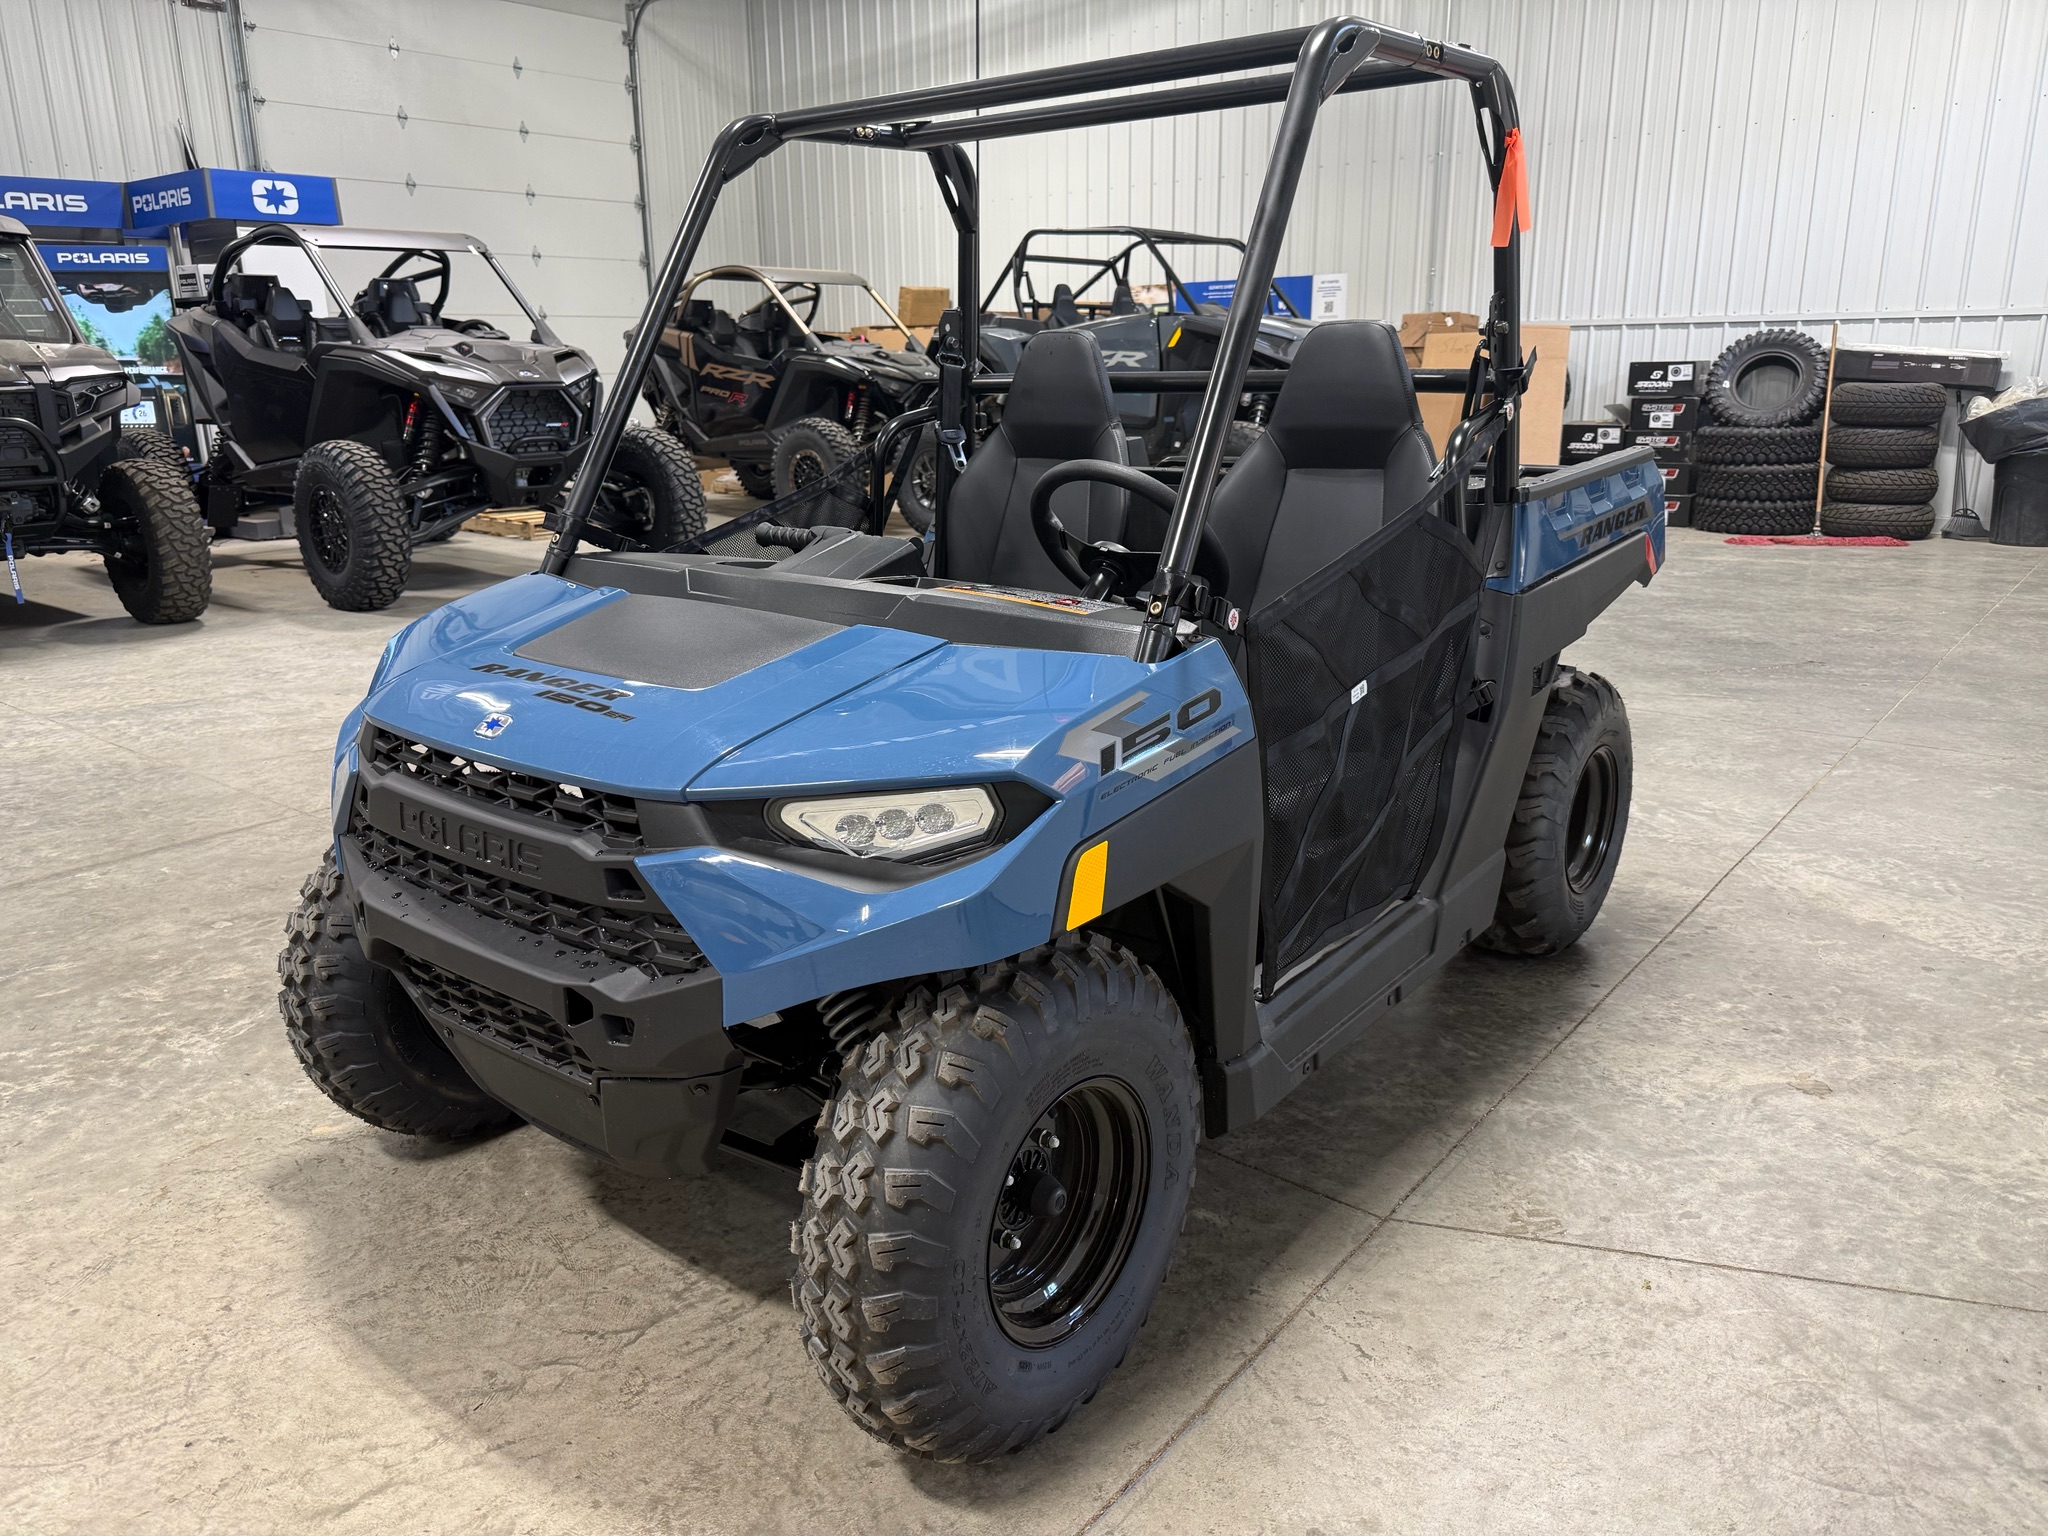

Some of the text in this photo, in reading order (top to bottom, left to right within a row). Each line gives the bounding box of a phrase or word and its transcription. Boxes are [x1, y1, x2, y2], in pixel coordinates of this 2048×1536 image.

[0, 191, 89, 213] ARIS
[132, 187, 192, 214] POLARIS
[56, 252, 150, 264] POLARIS
[1101, 350, 1148, 368] ZR
[700, 363, 777, 389] RZR
[700, 386, 731, 398] PRO
[1579, 501, 1646, 549] RANGER
[8, 555, 21, 591] POLARIS
[469, 663, 635, 702] RANGER
[531, 689, 613, 714] 150
[1100, 686, 1223, 780] 150
[1101, 721, 1233, 800] ELECTRONIC FUEL INJECTION
[399, 801, 543, 880] POLARIS
[1145, 1054, 1182, 1191] WANDA
